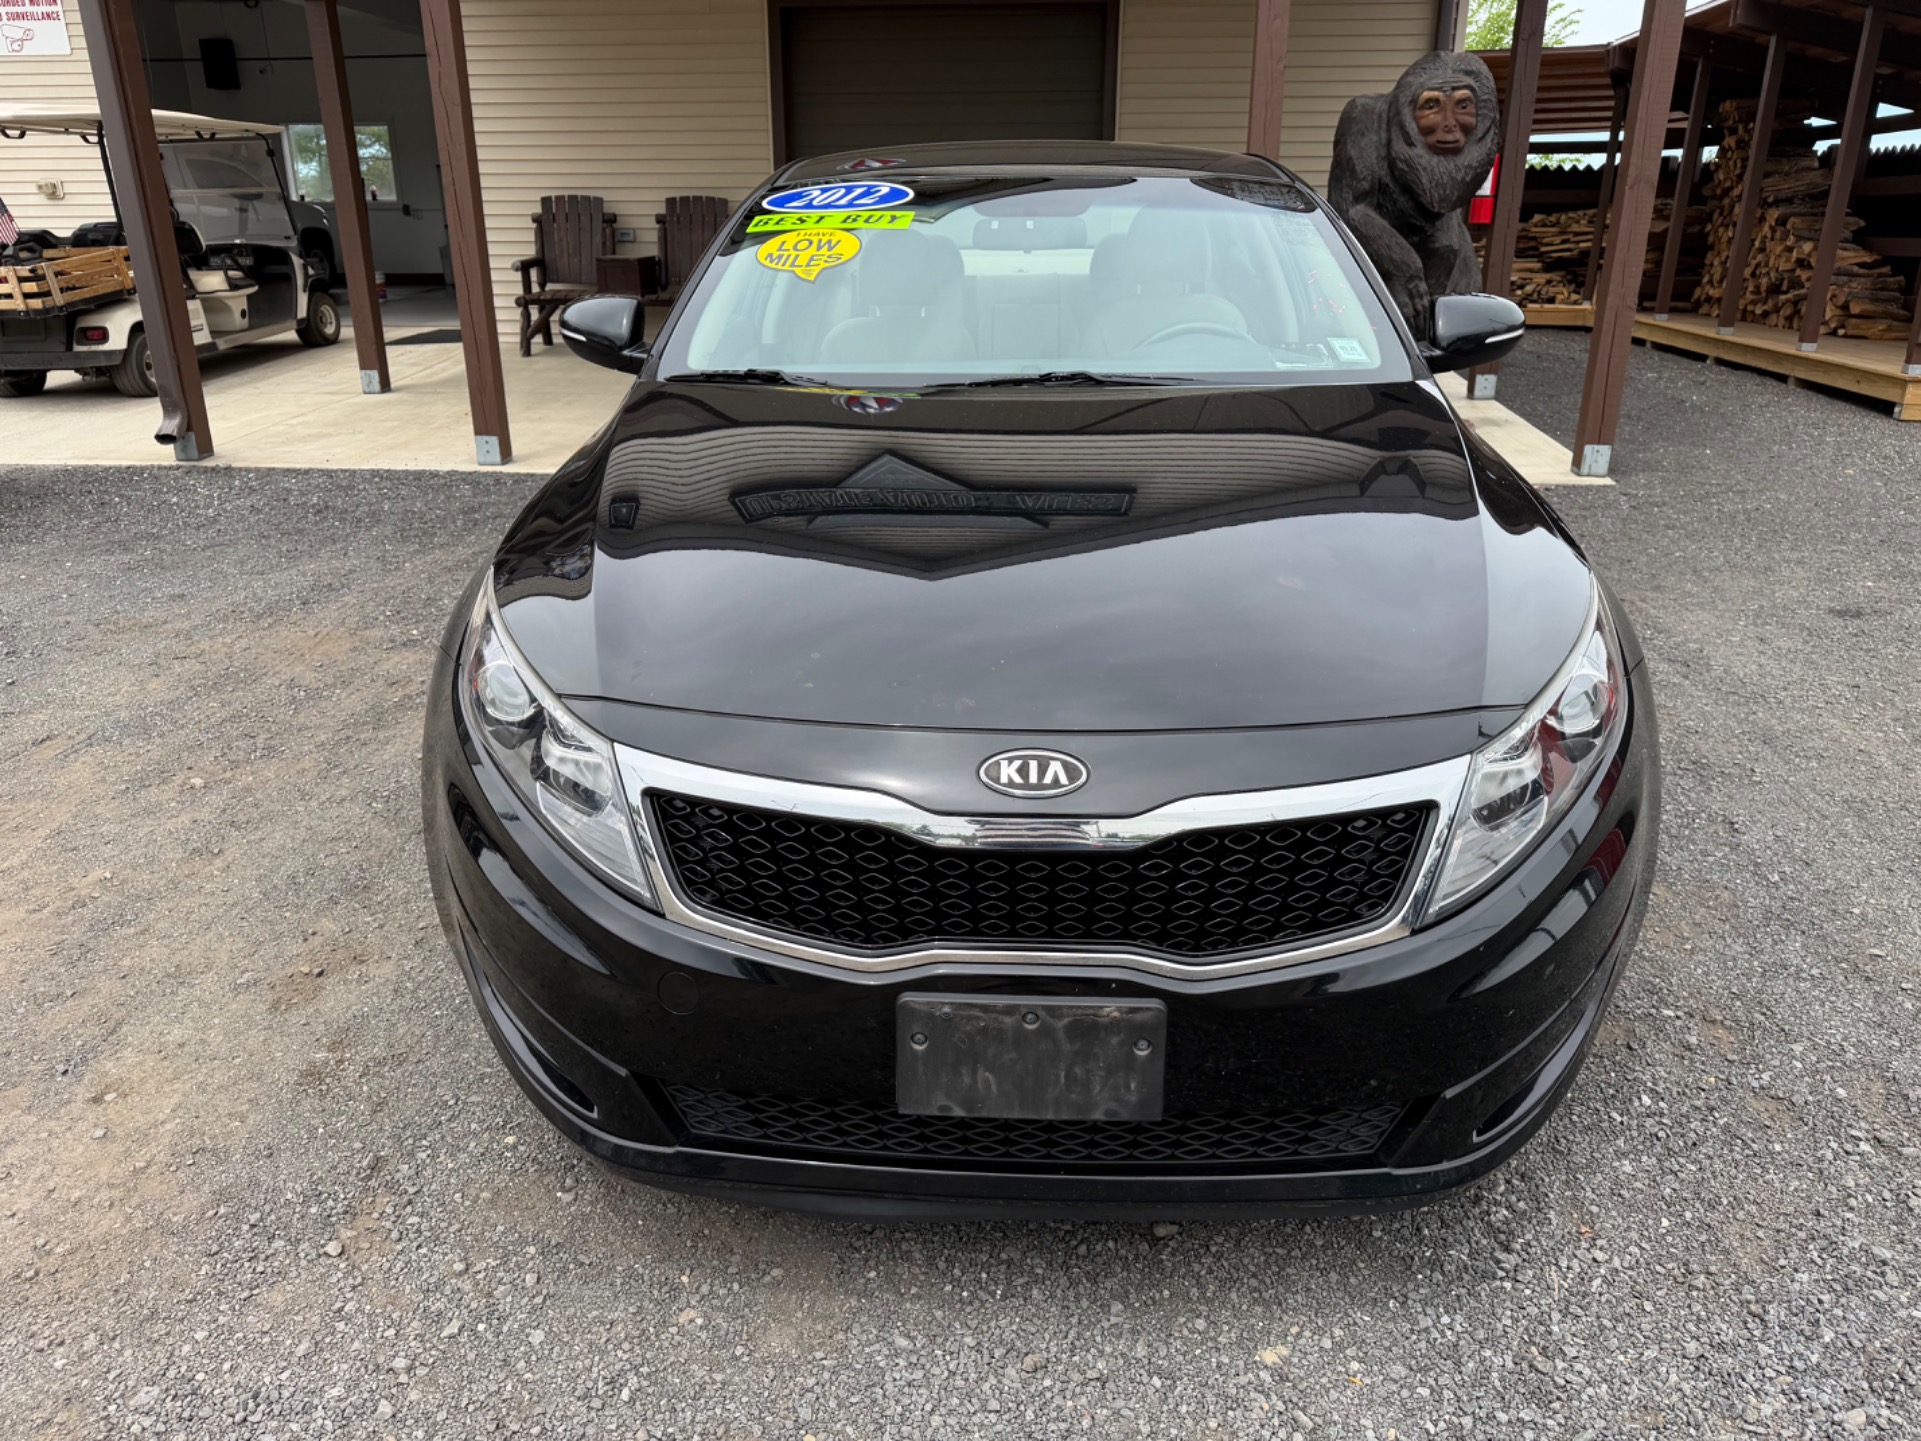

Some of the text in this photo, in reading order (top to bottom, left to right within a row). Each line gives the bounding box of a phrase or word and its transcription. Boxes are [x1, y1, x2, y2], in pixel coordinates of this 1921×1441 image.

[5, 11, 61, 21] SURVEILLANCE
[784, 186, 891, 207] 2012
[752, 213, 909, 227] BEST BUY
[776, 238, 842, 252] LOW
[764, 252, 844, 269] MILES
[999, 759, 1069, 785] KIA
